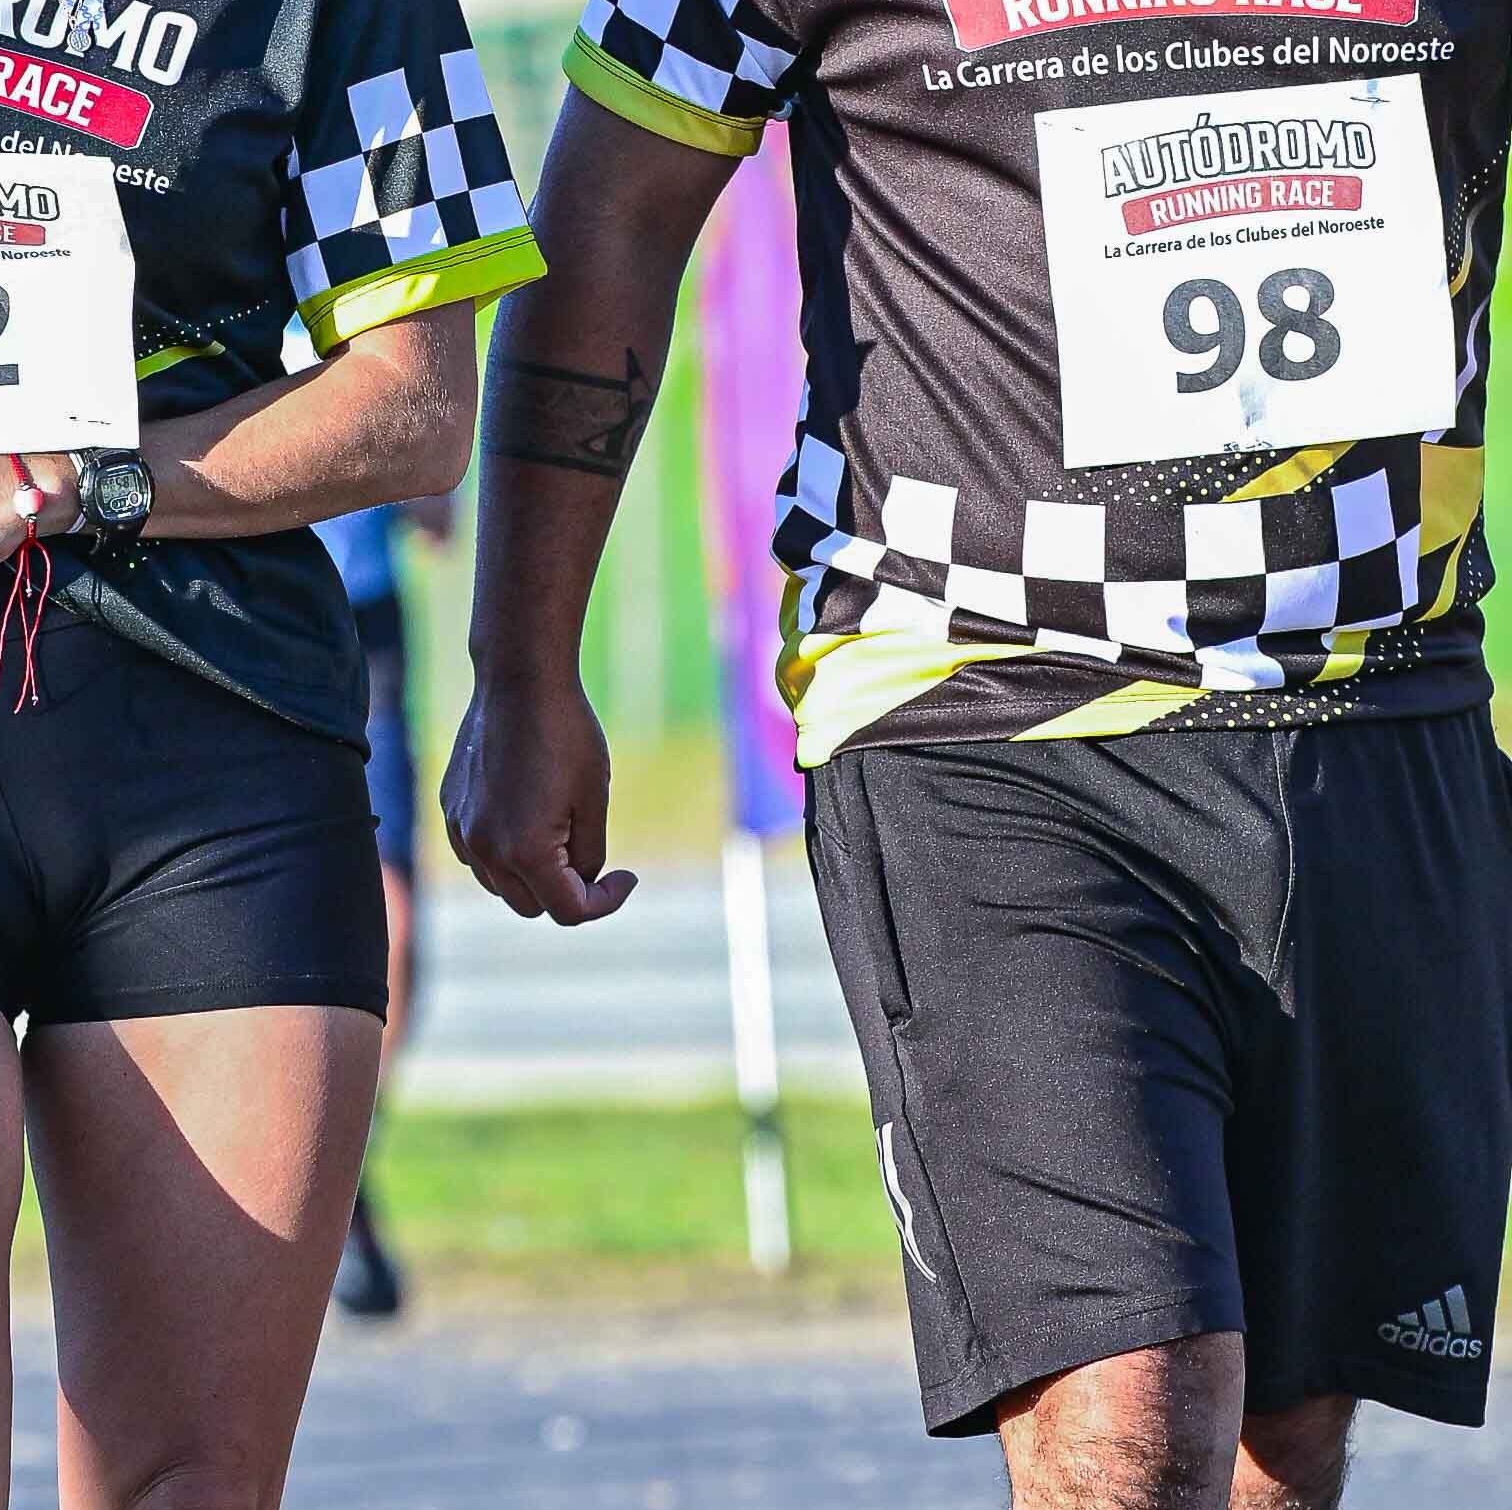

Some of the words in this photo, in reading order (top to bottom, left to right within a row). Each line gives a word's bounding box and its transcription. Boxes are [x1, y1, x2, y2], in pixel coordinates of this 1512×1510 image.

[922, 64, 954, 92] La
[956, 54, 1063, 88] Carrera
[1071, 47, 1109, 77] de
[1116, 44, 1158, 74] los
[1165, 40, 1265, 71] Clubes
[1272, 36, 1320, 66] del
[1328, 35, 1456, 65] Noroeste
[0, 131, 44, 154] del
[1101, 112, 1376, 198] AUTÓDROMO
[1150, 181, 1262, 227] RUNNING
[1271, 178, 1335, 207] RACE
[1, 248, 71, 260] Noroeste
[1104, 244, 1121, 259] La
[1125, 238, 1183, 258] Carrera
[1186, 234, 1207, 250] de
[1210, 231, 1232, 247] los
[1236, 226, 1287, 244] Clubes
[1291, 221, 1315, 237] del
[1318, 216, 1385, 235] Noroeste
[1163, 267, 1341, 394] 98
[1377, 1322, 1483, 1359] adidas
